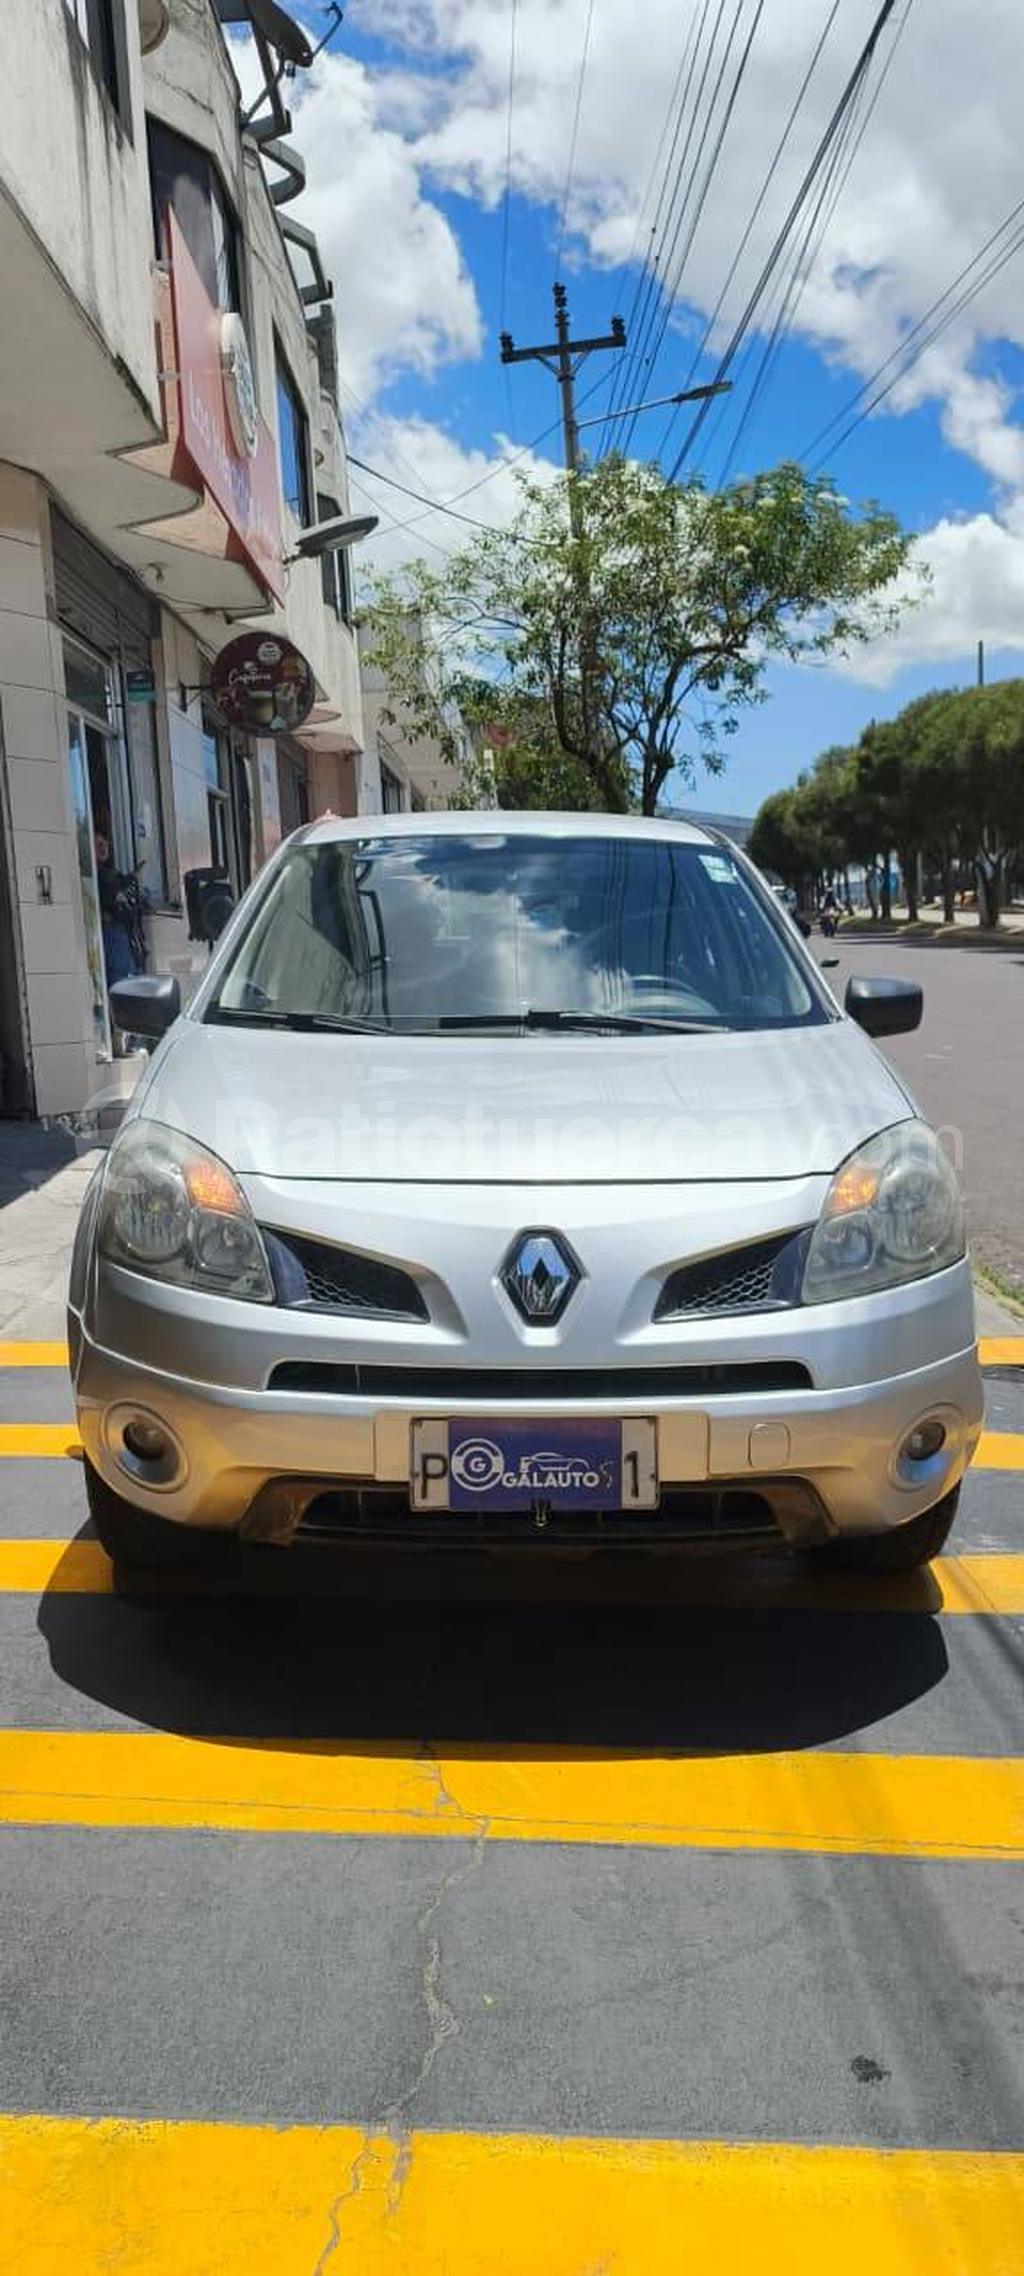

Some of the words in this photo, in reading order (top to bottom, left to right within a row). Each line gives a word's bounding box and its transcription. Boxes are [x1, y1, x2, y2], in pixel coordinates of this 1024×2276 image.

[421, 1454, 448, 1499] P
[470, 1458, 486, 1472] G
[624, 1450, 639, 1498] 1
